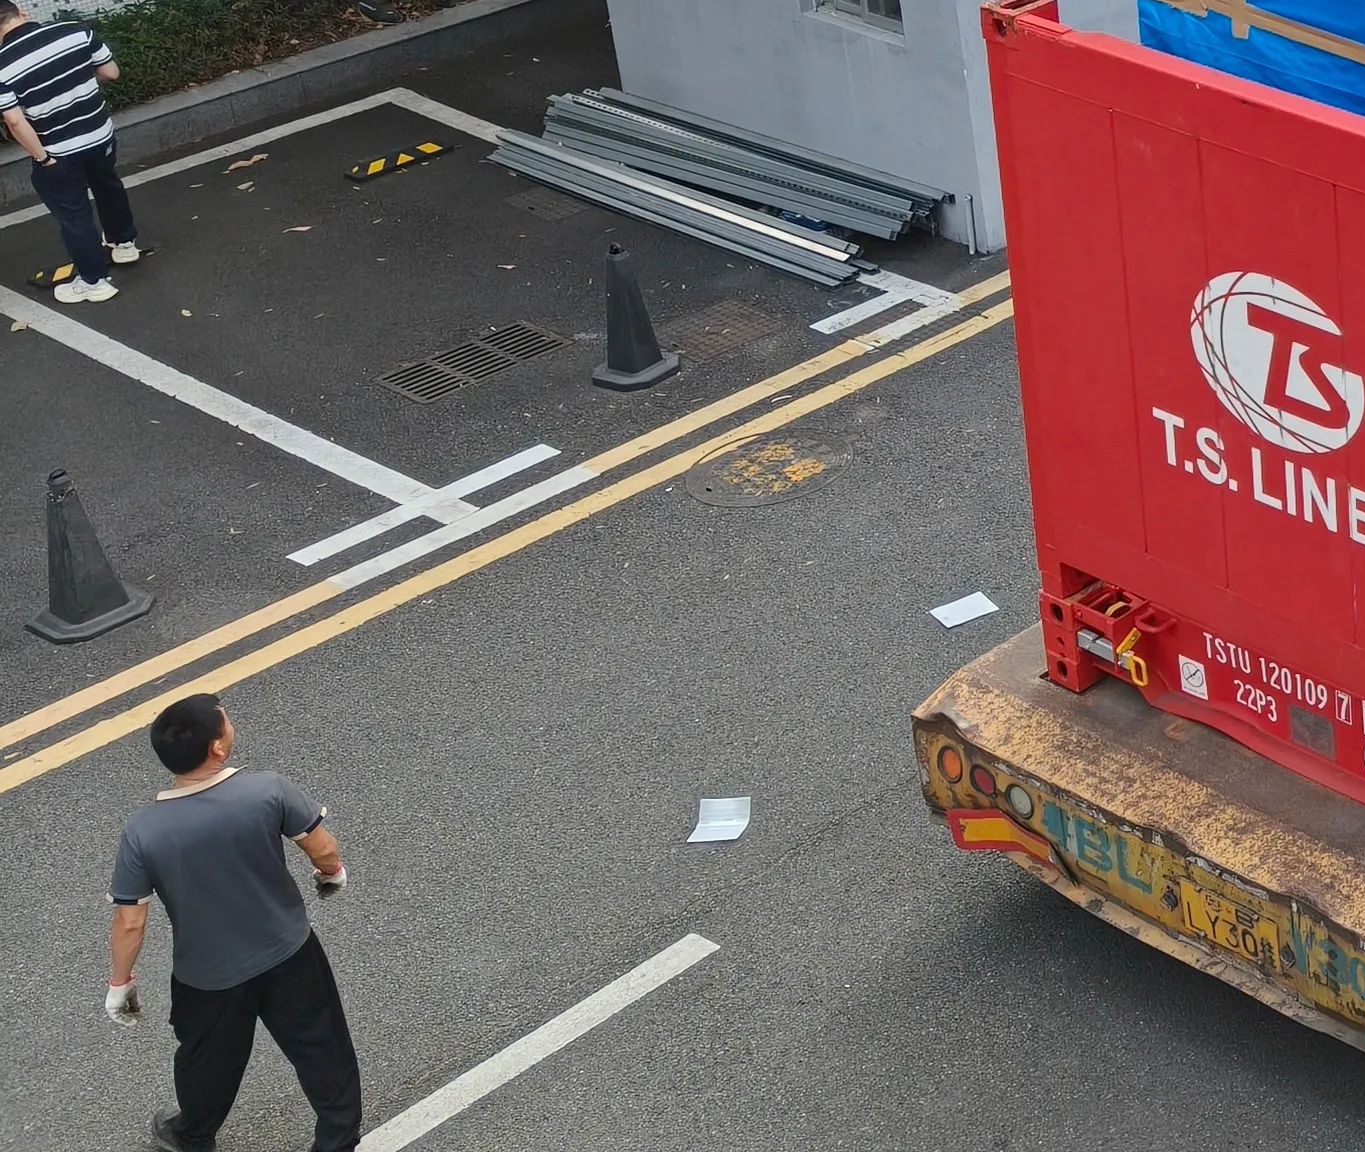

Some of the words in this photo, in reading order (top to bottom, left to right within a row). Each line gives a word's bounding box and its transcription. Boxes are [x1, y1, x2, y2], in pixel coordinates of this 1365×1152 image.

[1152, 406, 1238, 492] T.S.
[1203, 632, 1251, 675] TSTU
[1258, 656, 1328, 709] 120109
[1336, 690, 1350, 721] 7
[1232, 678, 1278, 723] 22P3
